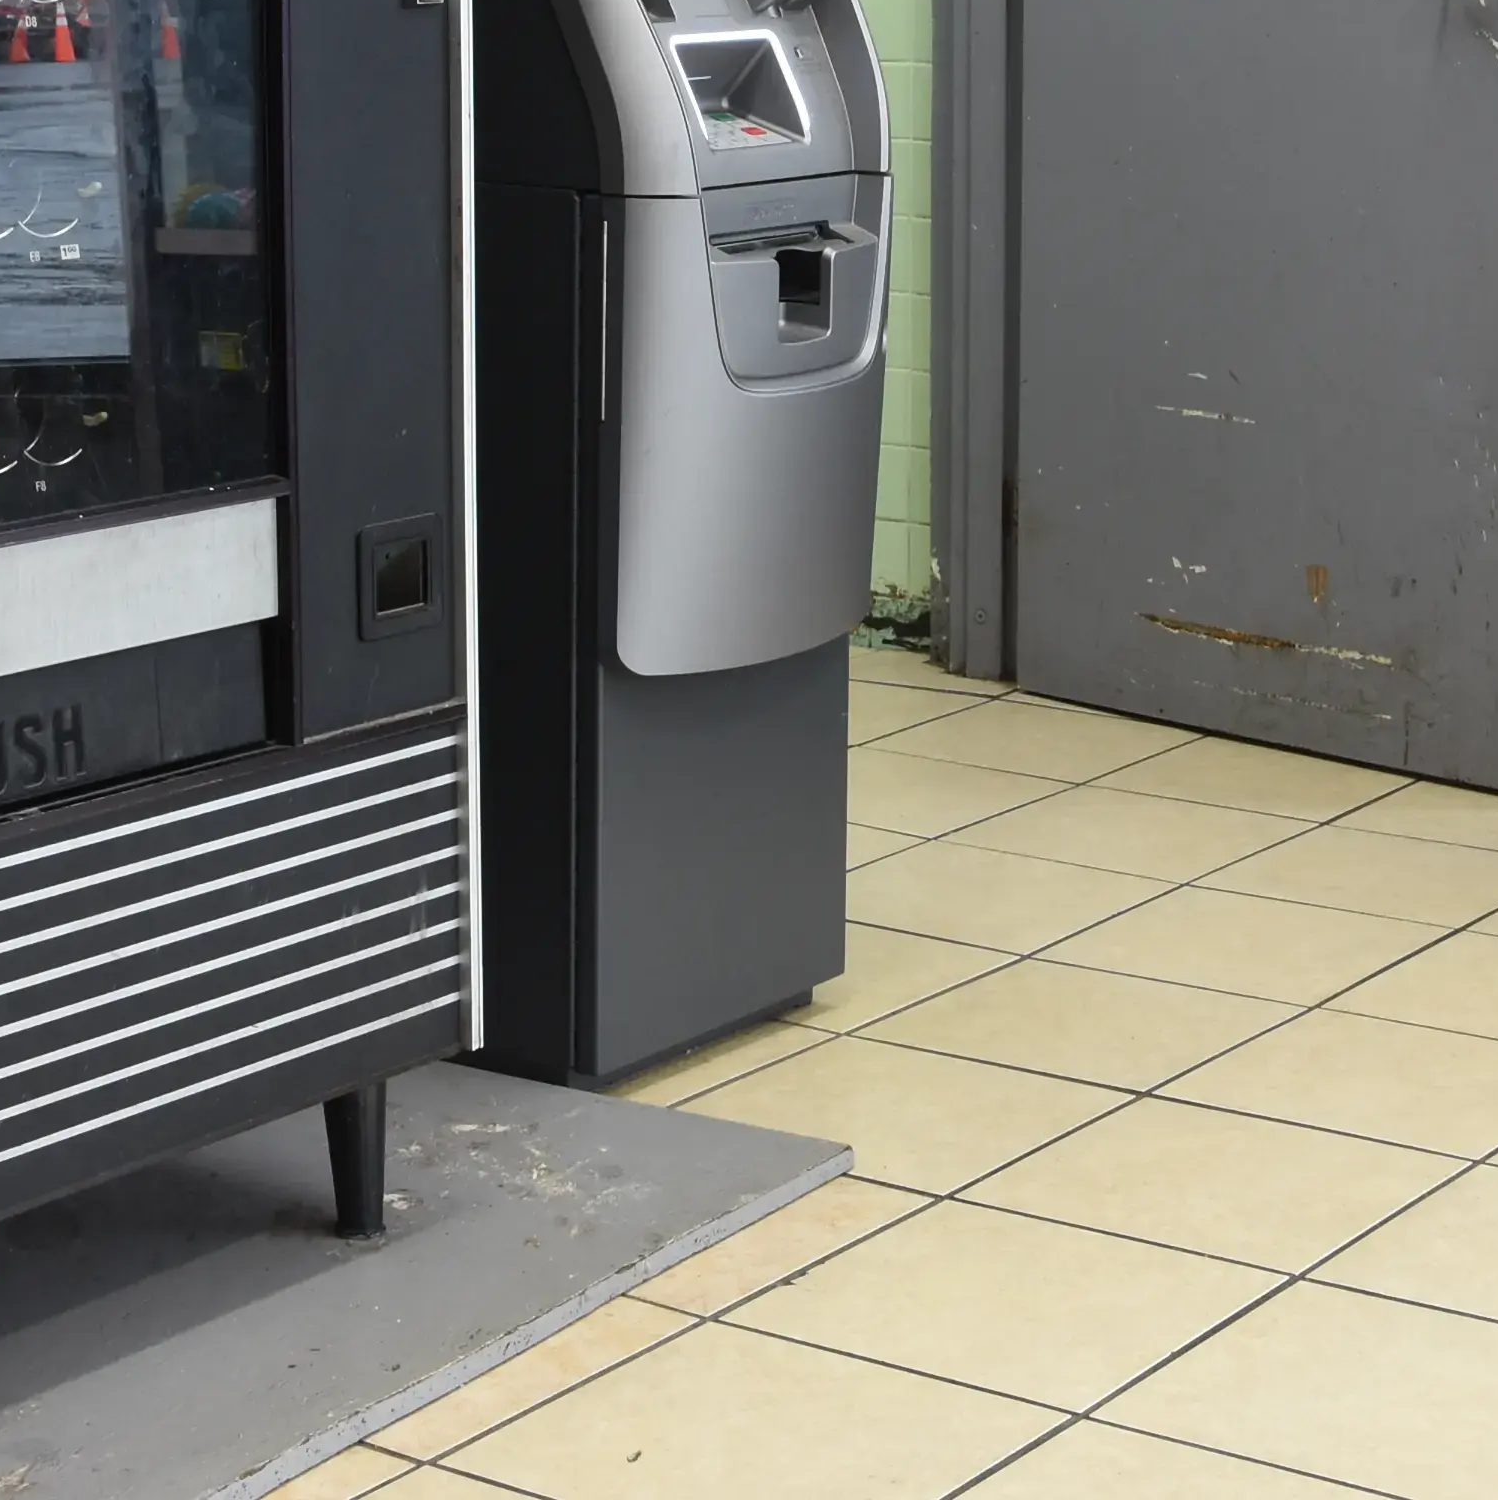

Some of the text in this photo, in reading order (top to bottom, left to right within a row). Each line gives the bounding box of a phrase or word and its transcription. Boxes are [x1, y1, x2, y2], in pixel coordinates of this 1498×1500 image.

[25, 16, 37, 28] D8
[29, 251, 41, 263] E8
[35, 480, 47, 492] F8
